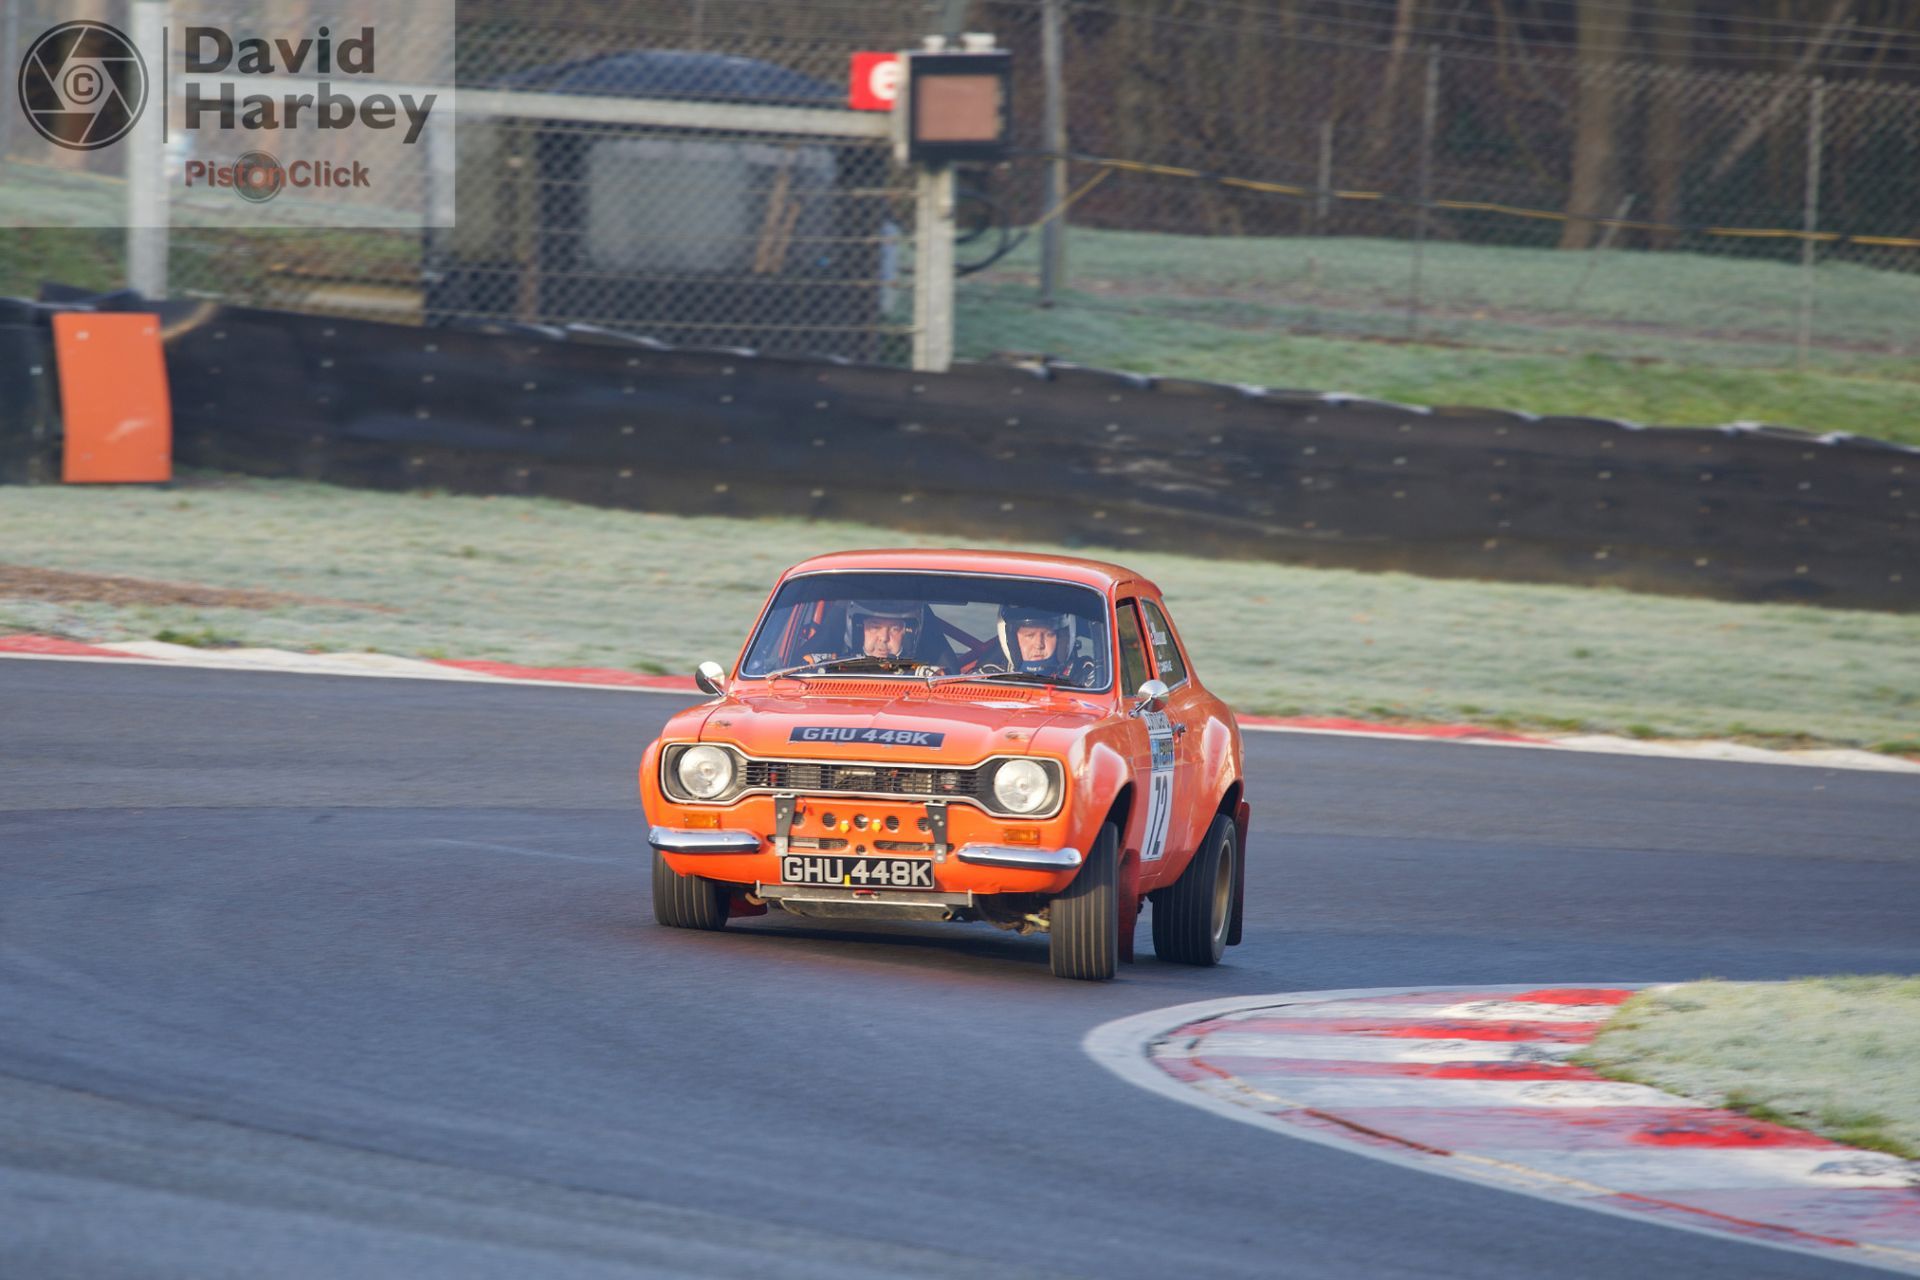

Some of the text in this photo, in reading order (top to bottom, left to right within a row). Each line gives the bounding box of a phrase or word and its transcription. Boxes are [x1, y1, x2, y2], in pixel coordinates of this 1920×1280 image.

[802, 727, 931, 744] GHU 448K
[1146, 776, 1168, 855] 72
[783, 857, 931, 885] GHU 448K
